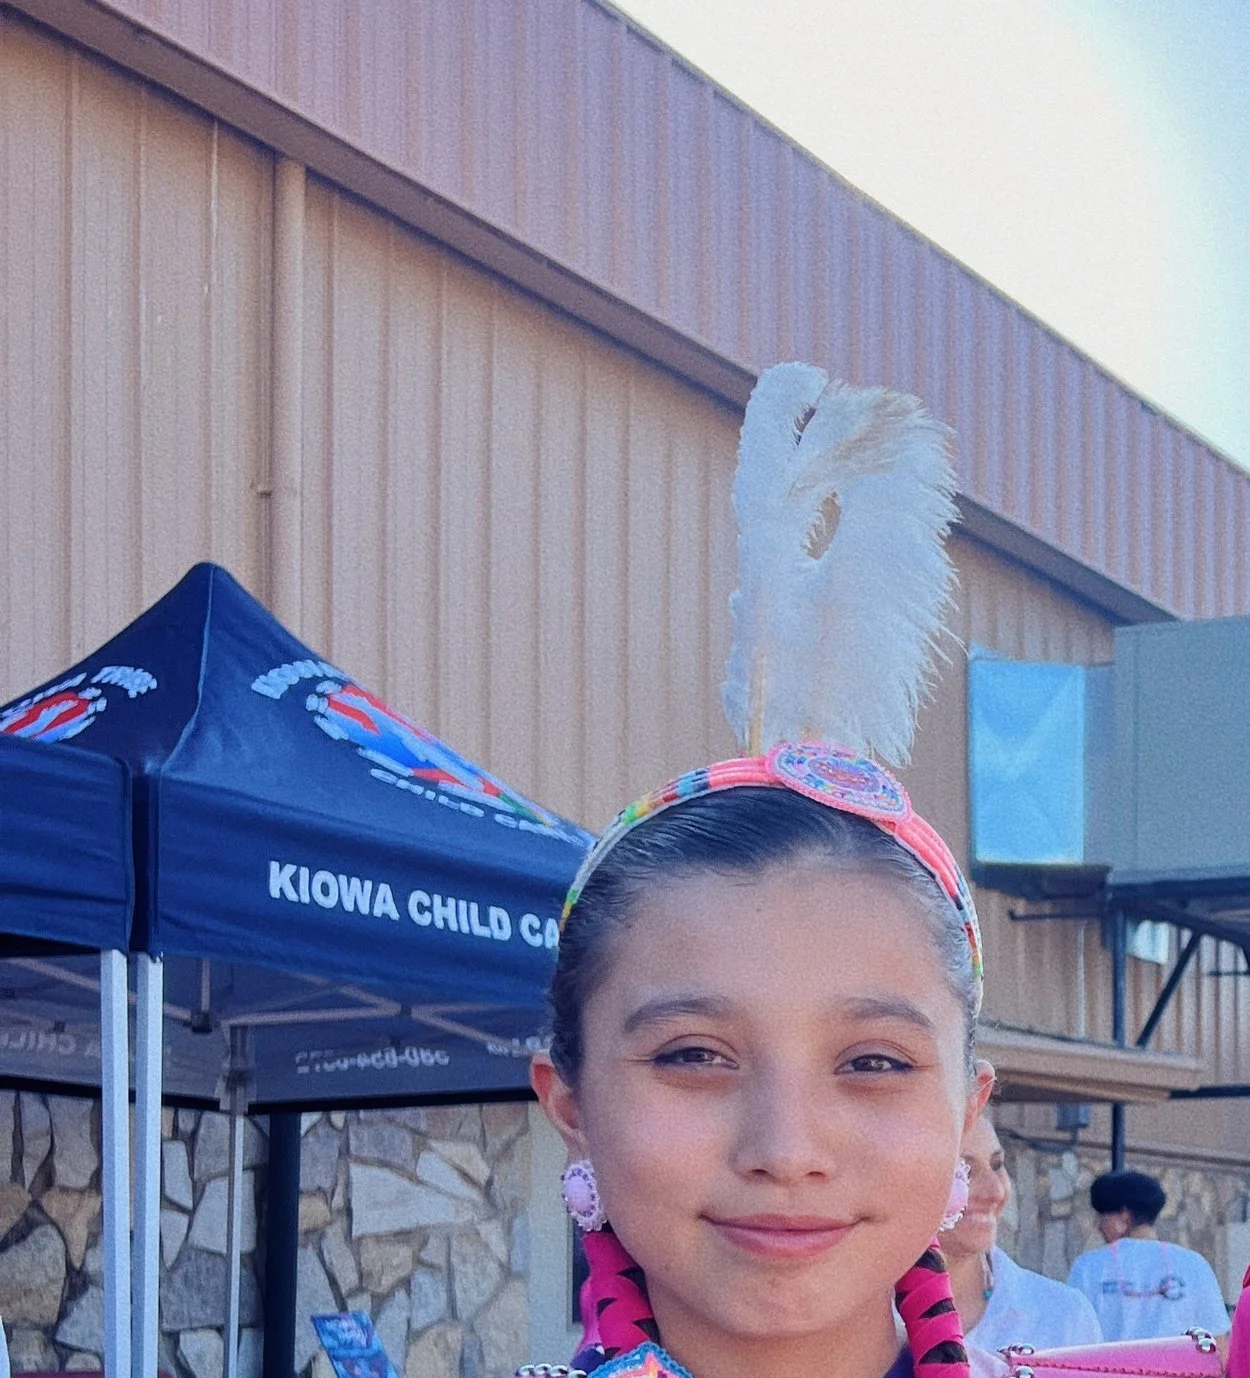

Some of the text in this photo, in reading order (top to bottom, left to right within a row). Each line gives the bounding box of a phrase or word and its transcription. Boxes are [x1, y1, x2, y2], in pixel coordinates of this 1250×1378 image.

[268, 859, 560, 949] KIOWA CHILD CA
